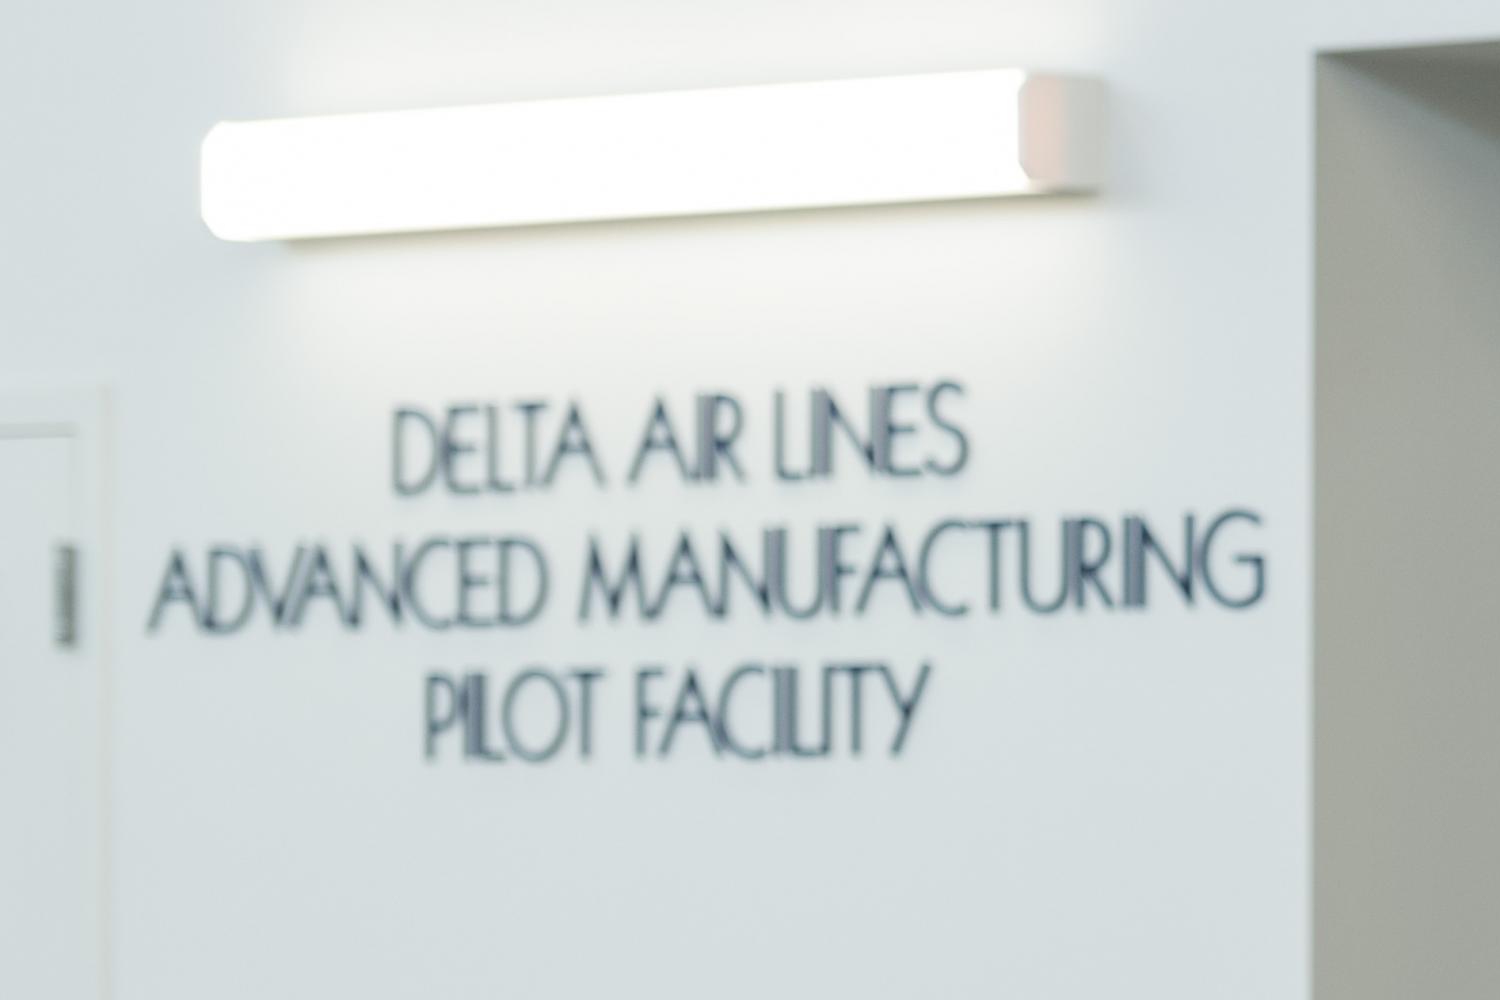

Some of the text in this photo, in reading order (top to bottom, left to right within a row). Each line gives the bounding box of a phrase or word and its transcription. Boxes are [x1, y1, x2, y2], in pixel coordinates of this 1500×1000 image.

[394, 380, 969, 495] DELTA AIR LINES
[147, 508, 1267, 635] ADVANCED MANUFACTURING
[424, 662, 932, 762] PILOT FACILITY
